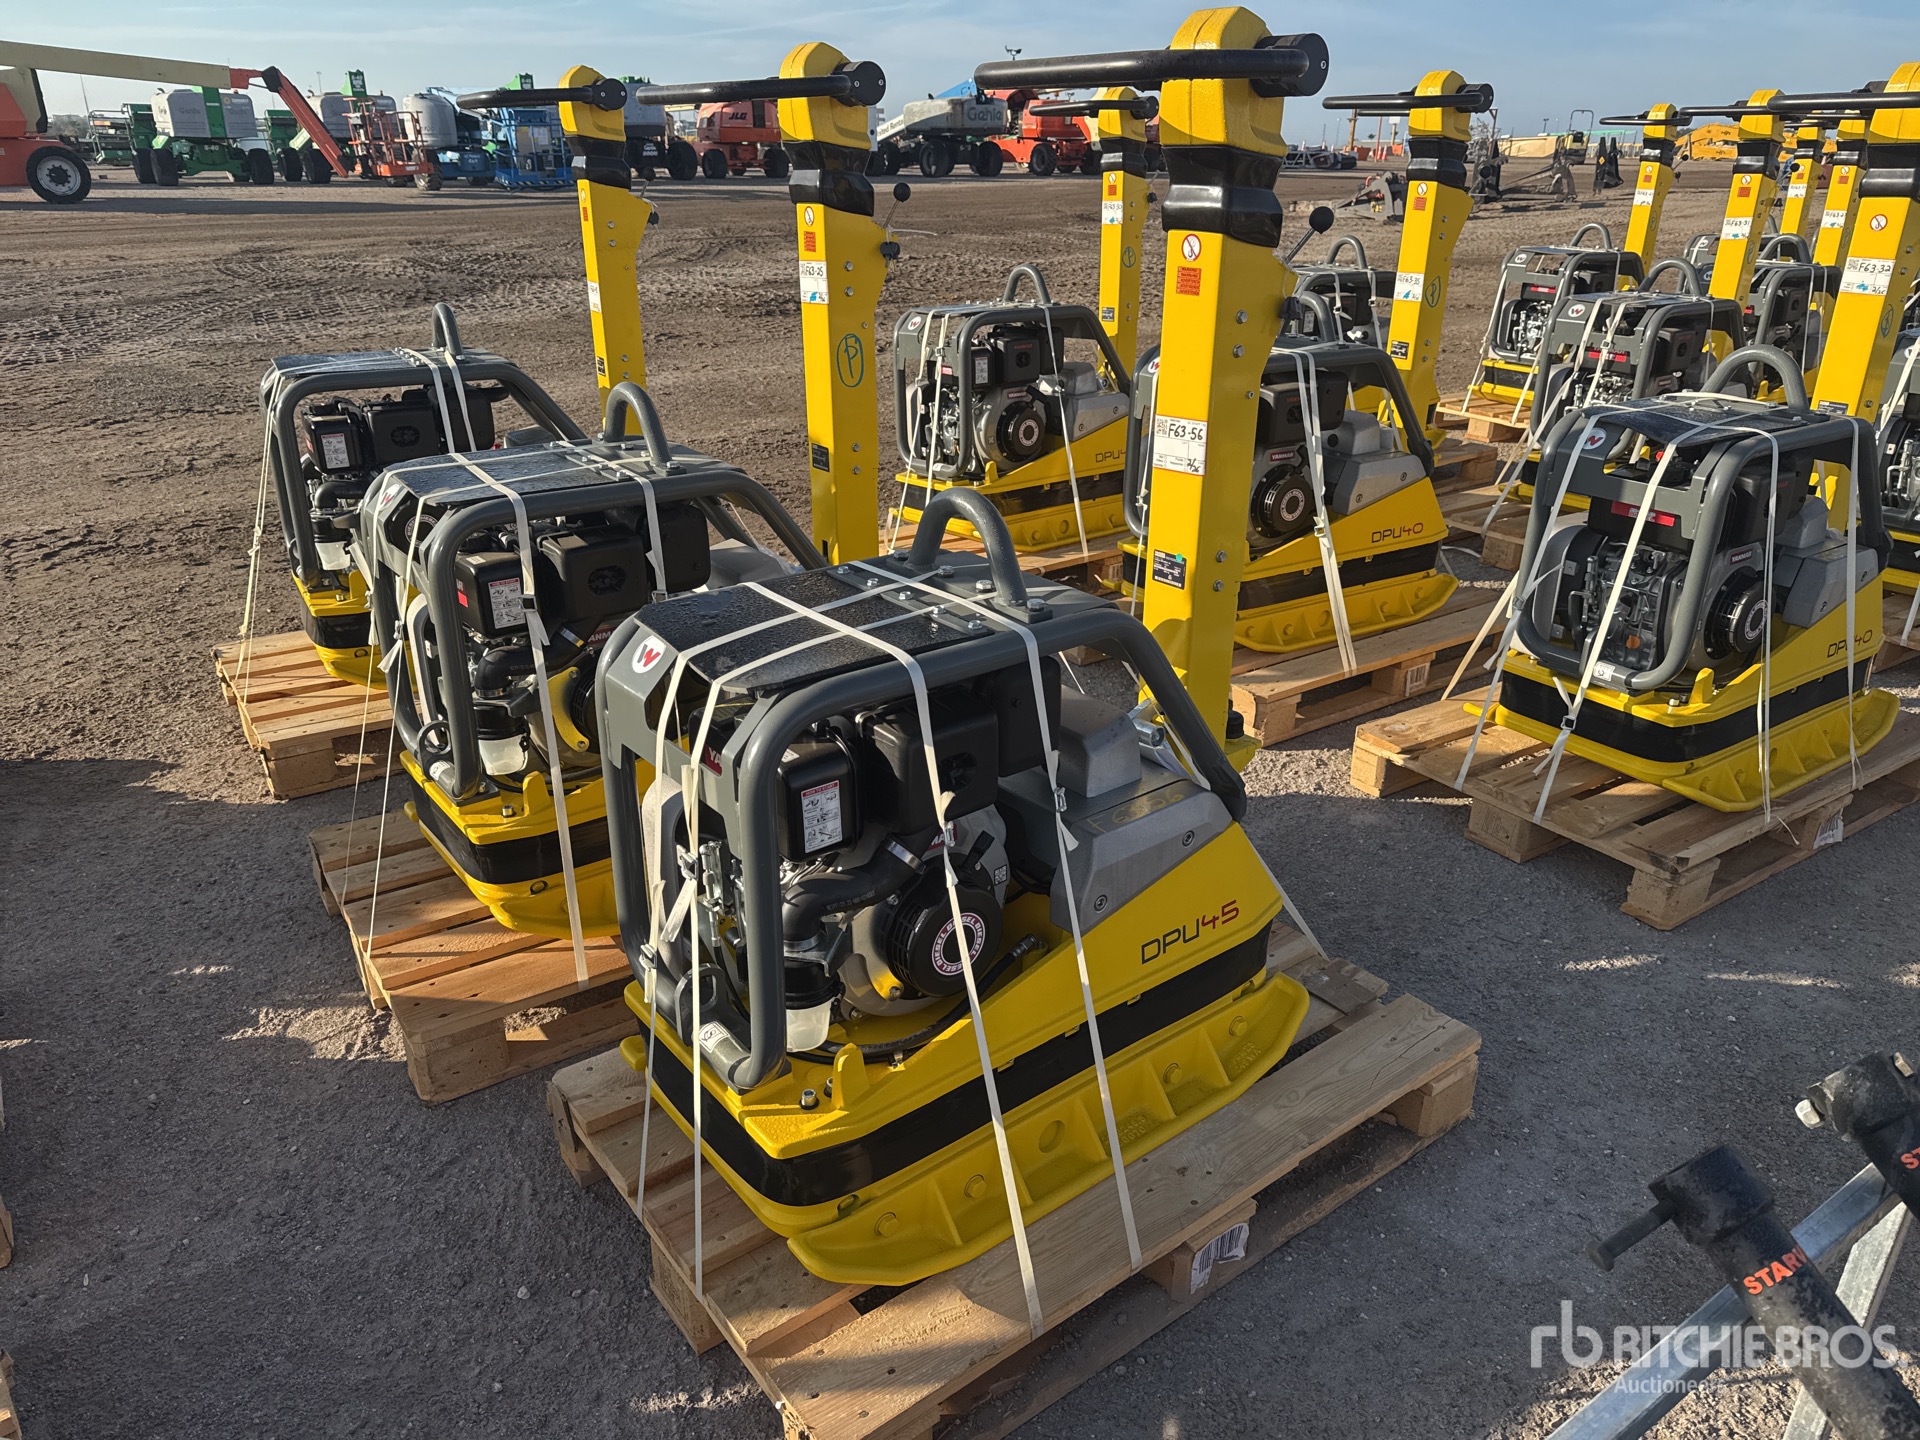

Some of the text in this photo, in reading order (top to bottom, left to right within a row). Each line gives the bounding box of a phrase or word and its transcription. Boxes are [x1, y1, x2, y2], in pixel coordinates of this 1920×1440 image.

[729, 112, 747, 120] JLG
[967, 106, 1003, 121] Genie
[1858, 262, 1892, 274] F63-32
[1167, 423, 1204, 441] F63-56
[1271, 451, 1295, 461] YANMAR
[1371, 522, 1424, 544] DPU40
[588, 629, 613, 643] ANM
[1140, 899, 1240, 965] DPU45
